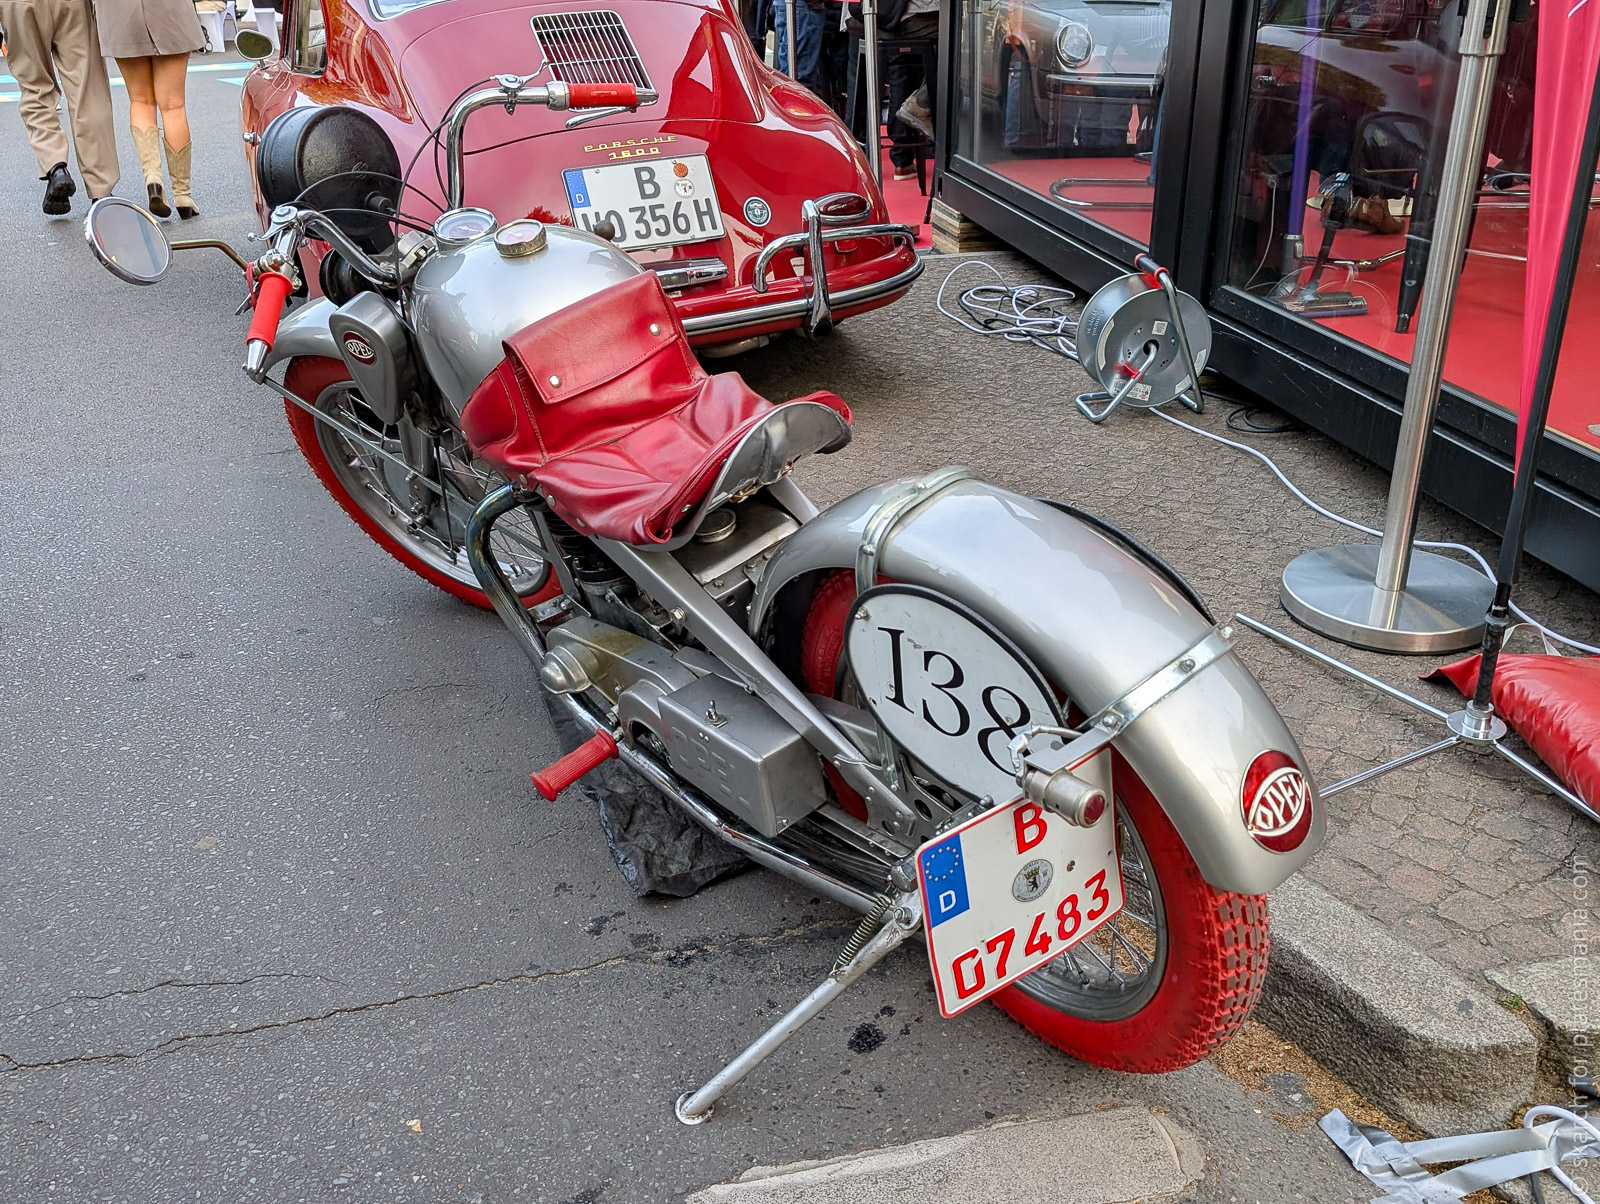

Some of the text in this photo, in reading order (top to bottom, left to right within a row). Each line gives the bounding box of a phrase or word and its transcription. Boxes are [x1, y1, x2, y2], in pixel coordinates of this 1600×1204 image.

[584, 135, 677, 152] PORSCHE
[608, 147, 661, 160] 1600
[633, 166, 661, 200] B
[575, 193, 585, 204] D
[347, 342, 372, 356] OPEL
[877, 627, 1032, 777] 138
[1255, 773, 1303, 829] OPEL
[1013, 802, 1048, 855] B
[938, 890, 957, 914] D
[951, 868, 1110, 1000] 07483
